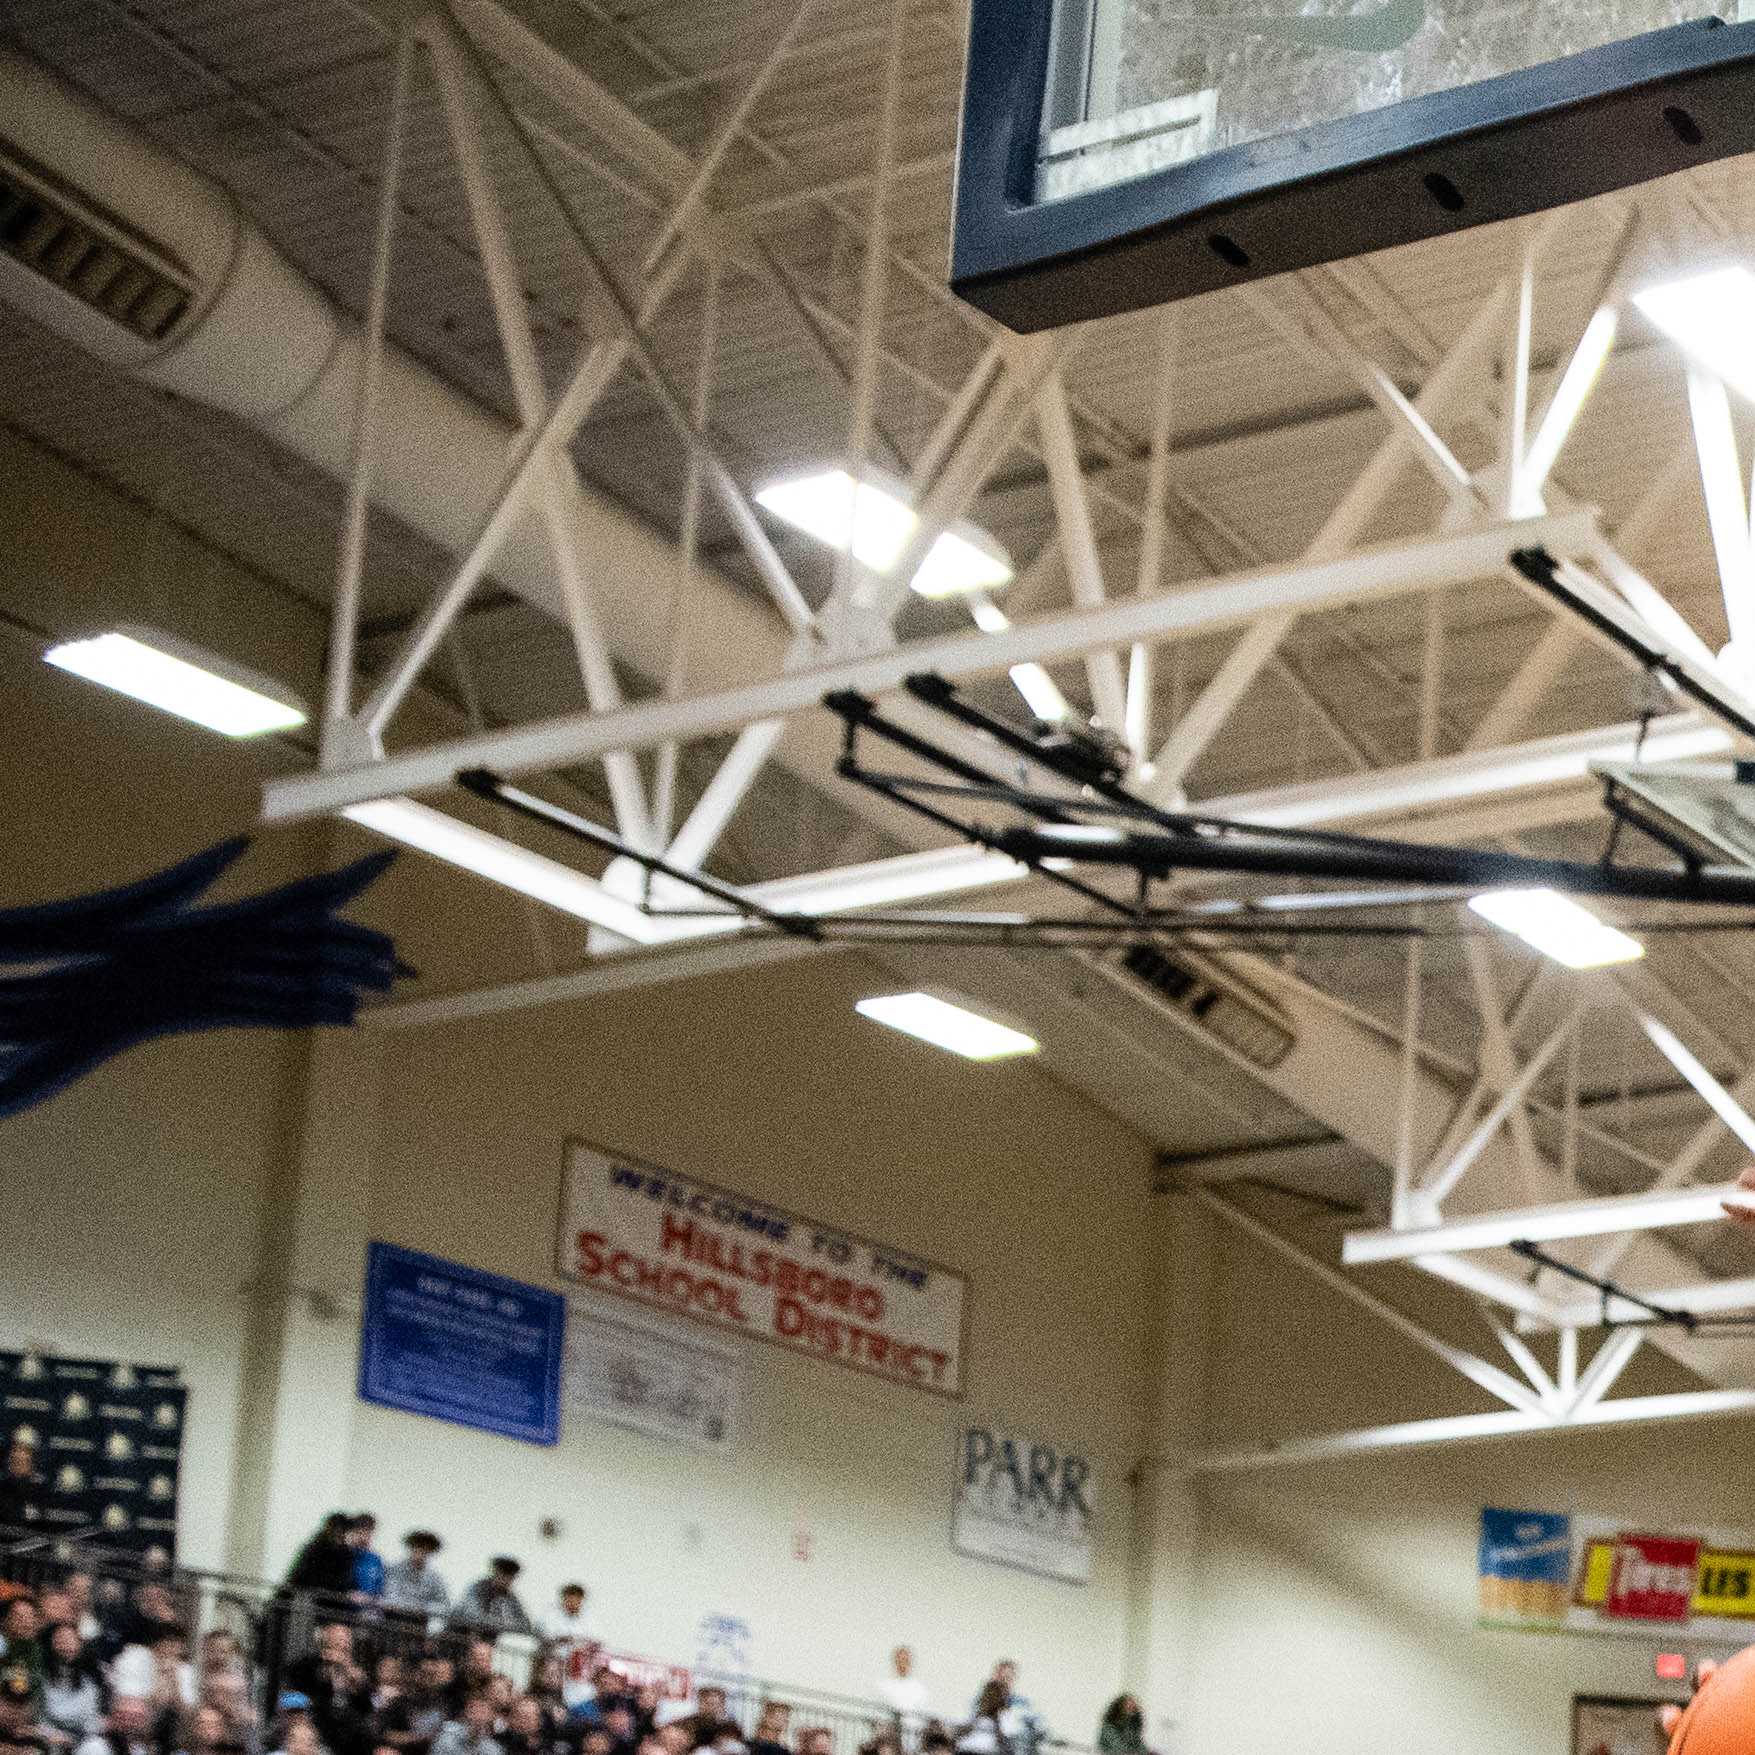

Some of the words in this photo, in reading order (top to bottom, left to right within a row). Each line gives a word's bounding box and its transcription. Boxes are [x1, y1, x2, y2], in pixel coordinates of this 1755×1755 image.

[610, 1164, 789, 1242] WELCOME
[812, 1234, 853, 1265] TO
[870, 1254, 929, 1292] THE
[577, 1230, 749, 1323] SCHOOL
[774, 1296, 950, 1381] DISTRICT
[1701, 1566, 1751, 1600] LES
